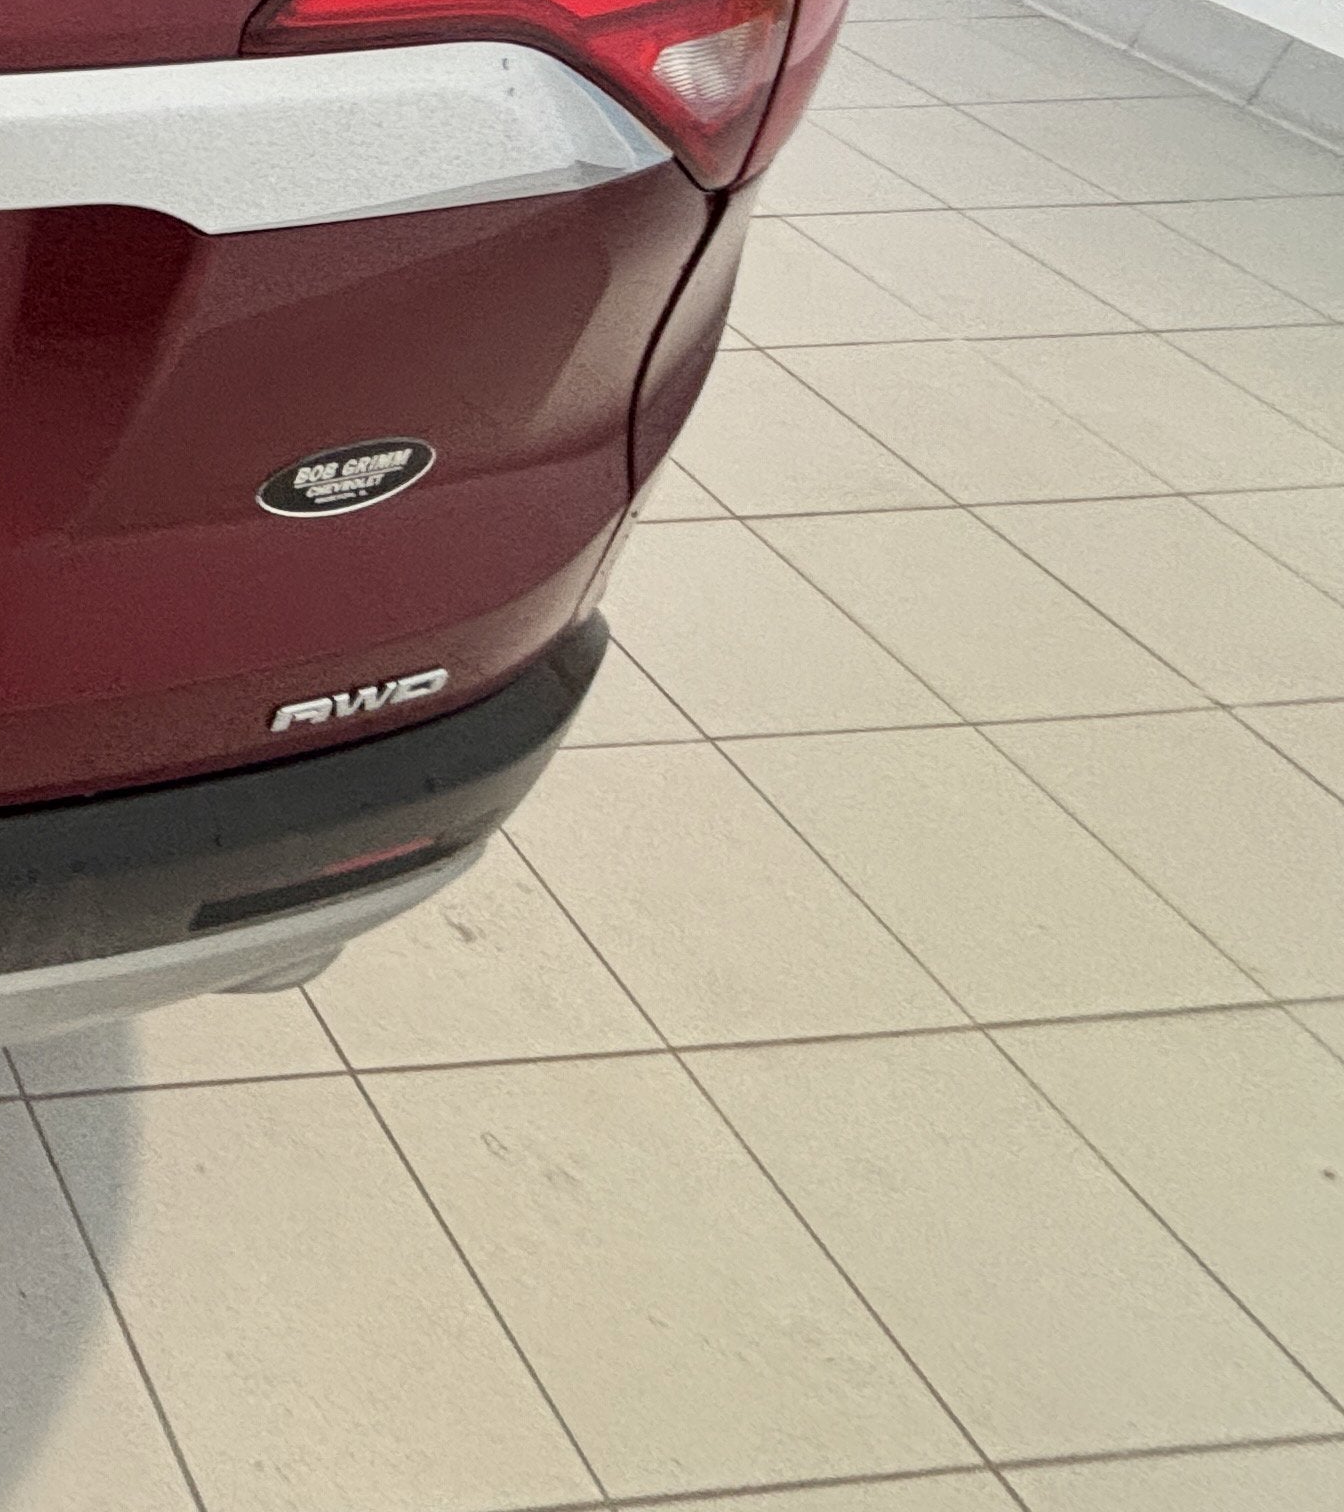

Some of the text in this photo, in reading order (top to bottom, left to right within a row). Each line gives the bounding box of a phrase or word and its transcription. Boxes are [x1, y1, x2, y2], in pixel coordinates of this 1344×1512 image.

[293, 448, 413, 486] BOB GRIMM
[269, 667, 449, 732] AWD
